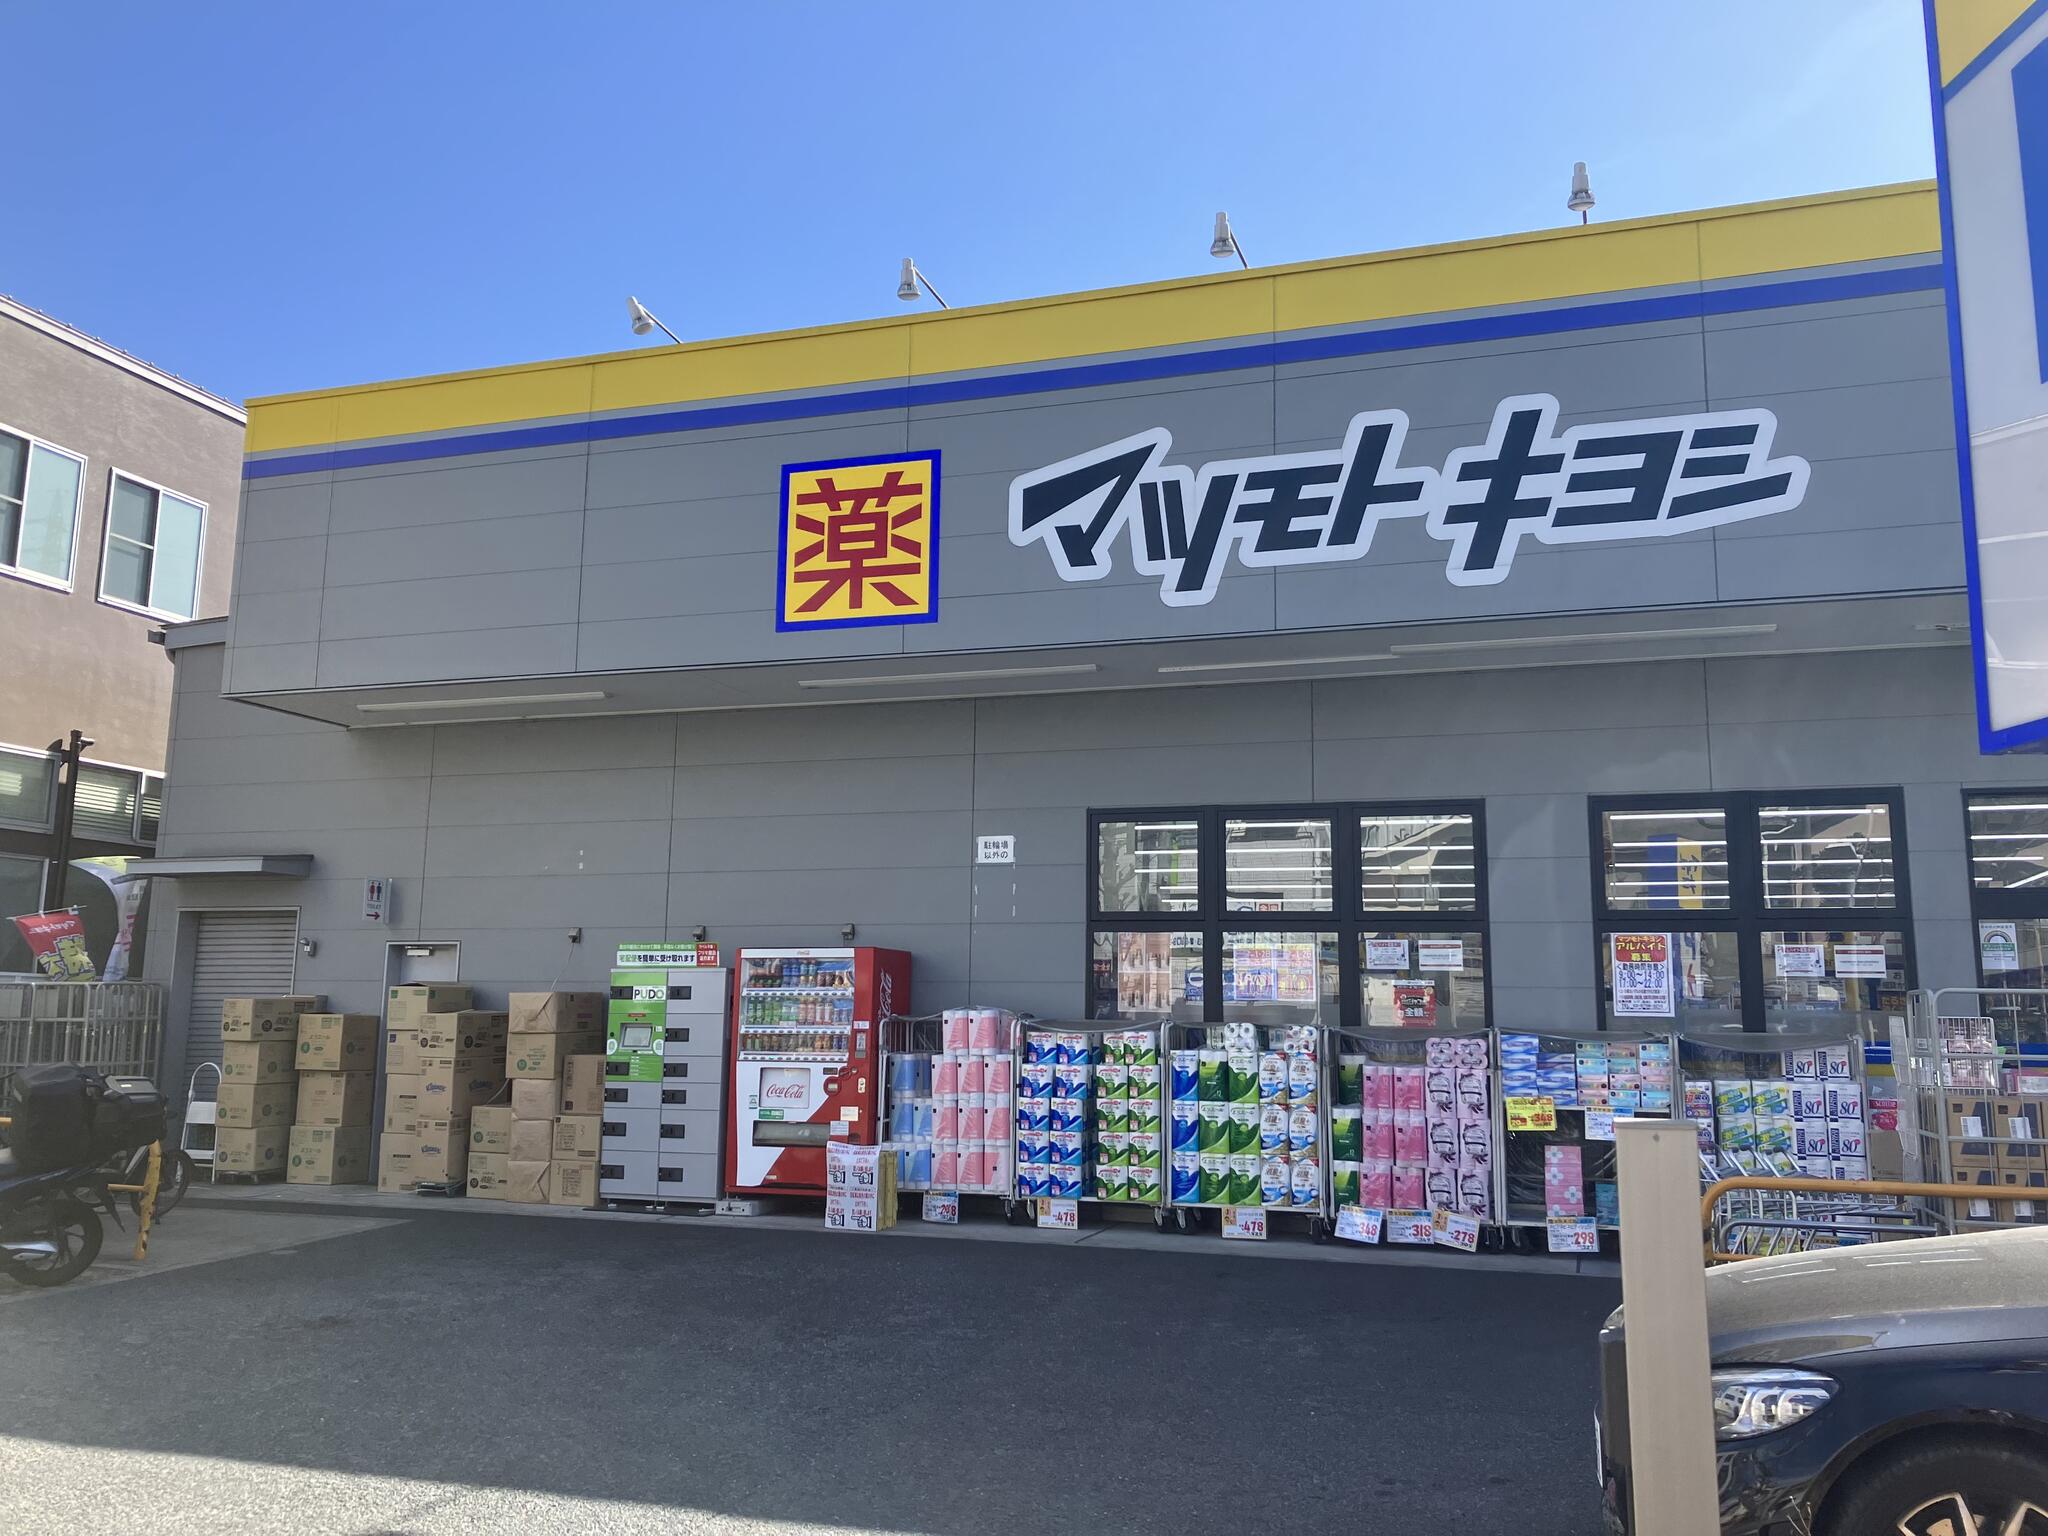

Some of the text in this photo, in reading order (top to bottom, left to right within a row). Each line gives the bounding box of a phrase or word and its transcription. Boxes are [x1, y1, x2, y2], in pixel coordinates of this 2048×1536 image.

[1018, 408, 1791, 592] マツモトキヨシ
[793, 468, 925, 614] 薬
[984, 840, 1008, 849] 駐輪場
[984, 850, 1008, 859] 以外の
[1616, 942, 1666, 951] アルバイト
[1631, 952, 1652, 962] 募集
[634, 989, 665, 999] PUDO
[767, 1083, 806, 1099] Coca-Cola
[1056, 1211, 1076, 1222] 478
[1243, 1221, 1264, 1231] 478
[1411, 1224, 1432, 1237] 318
[1453, 1229, 1475, 1244] 278
[1573, 1231, 1595, 1245] 298
